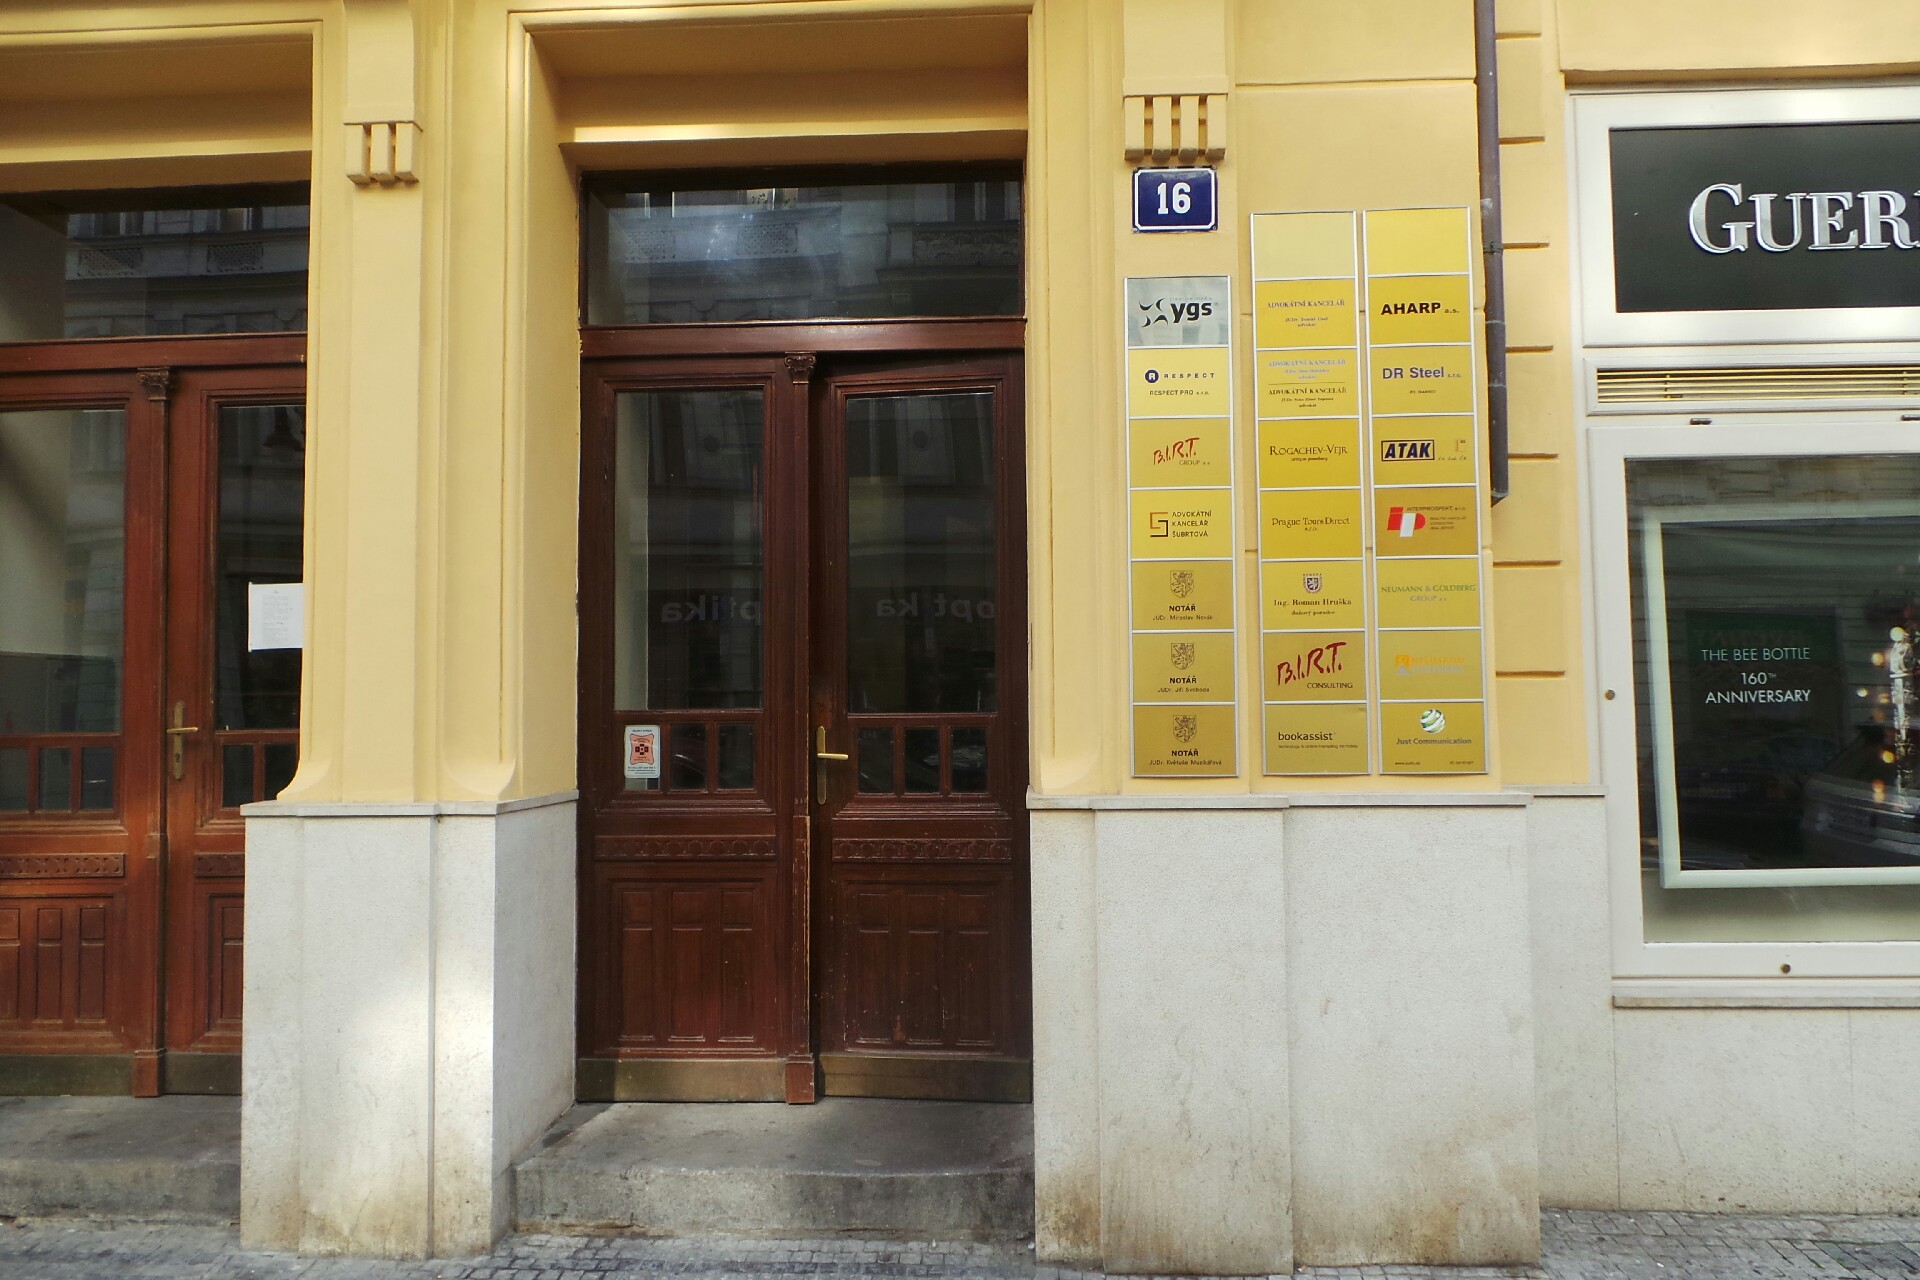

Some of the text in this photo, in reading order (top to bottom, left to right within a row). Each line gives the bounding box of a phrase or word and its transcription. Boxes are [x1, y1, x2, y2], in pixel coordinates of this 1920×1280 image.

[1157, 182, 1191, 215] 16
[1688, 182, 1920, 254] GUER
[1268, 298, 1345, 308] ADVOKÁTNÍ KANCELÁŘ
[1170, 302, 1213, 324] ygs
[1380, 302, 1441, 316] AHARP
[1382, 367, 1404, 380] DR
[1409, 366, 1444, 379] Steel
[1268, 386, 1347, 396] ADVOKÁTNÍ KANCELÁŘ
[1152, 436, 1201, 466] B.I.R.T.
[1384, 442, 1432, 459] ATAK
[1171, 509, 1212, 518] ADVOKÁTNÍ
[1171, 519, 1209, 527] KANCELÁŘ
[1271, 516, 1350, 529] Prague Tours Direct
[1171, 530, 1209, 538] ŠUBRTOVÁ
[1380, 585, 1423, 593] NEUMANN
[1432, 584, 1476, 592] GOLDBERG
[1168, 603, 1196, 612] NOTÁŘ
[1273, 599, 1290, 607] Ing.
[1701, 647, 1811, 662] THE BEE BOTTLE
[1277, 641, 1348, 687] B.I.R.T.
[1169, 675, 1197, 684] NOTÁŘ
[1704, 689, 1811, 704] ANNIVERSARY
[1278, 731, 1334, 741] bookassist
[1396, 737, 1472, 745] Just Communication
[1171, 748, 1199, 757] NOTÁŘ
